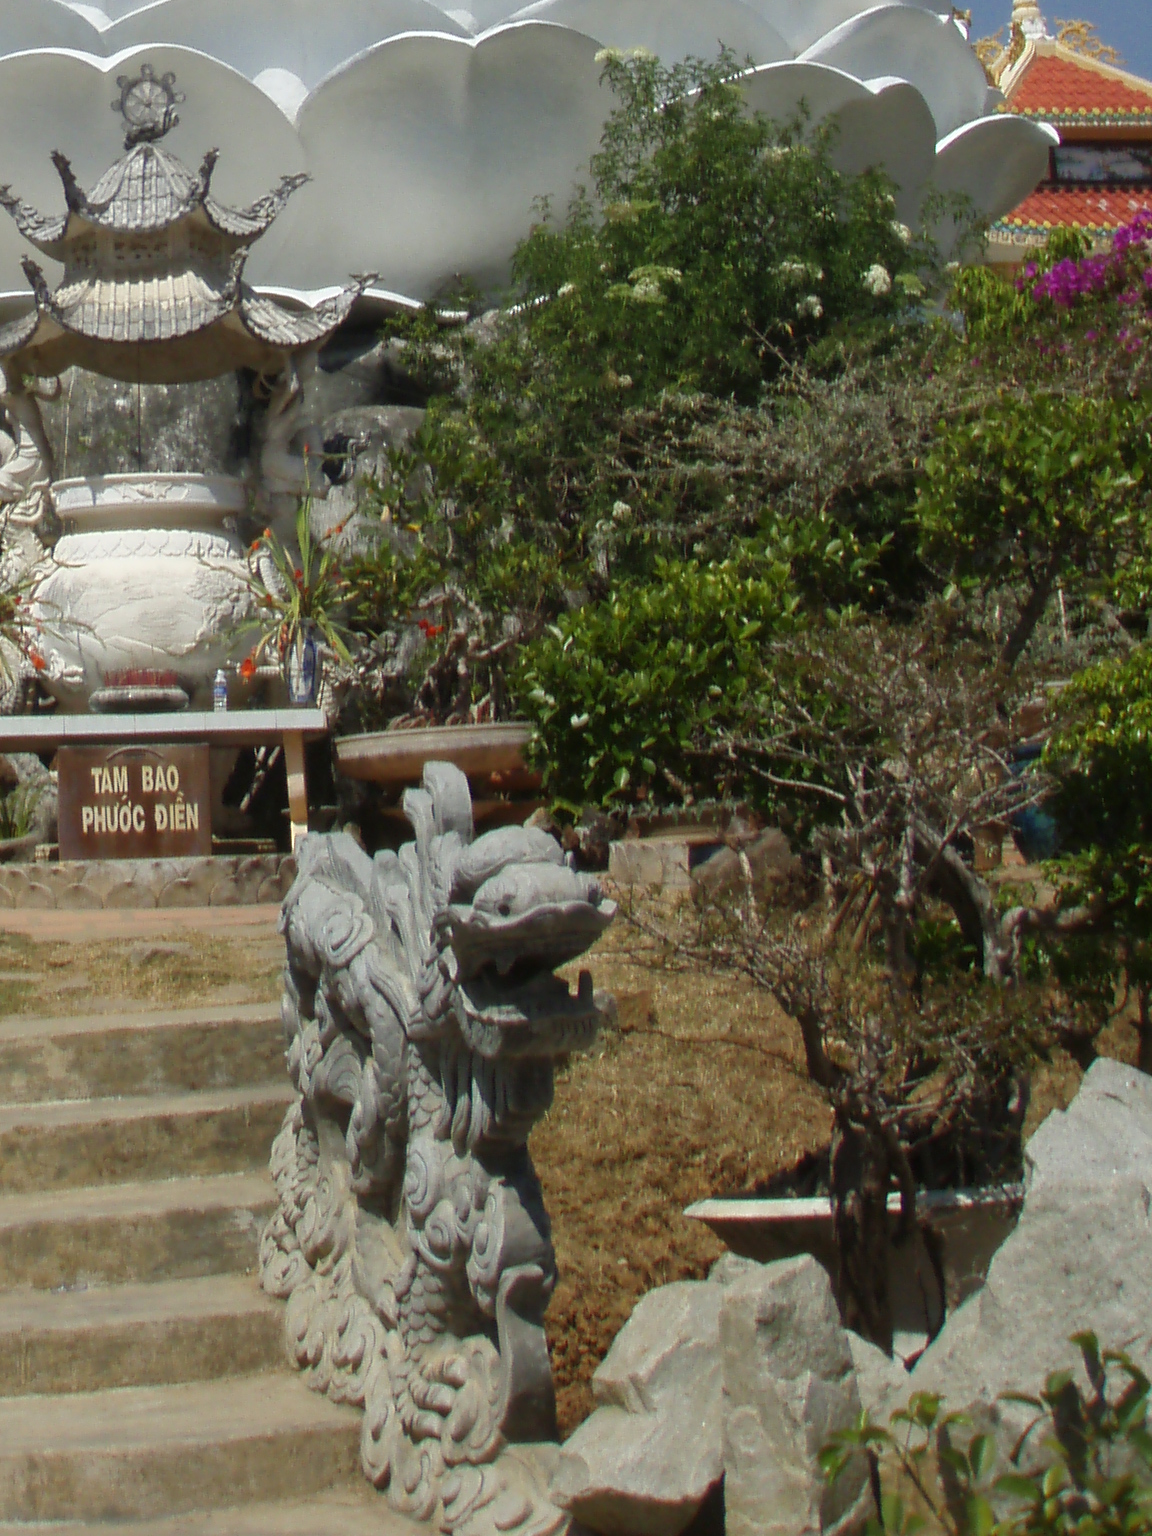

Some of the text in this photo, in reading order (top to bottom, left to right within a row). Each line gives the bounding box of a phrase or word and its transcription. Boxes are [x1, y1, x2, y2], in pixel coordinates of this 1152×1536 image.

[91, 766, 128, 794] TAM
[82, 791, 199, 833] PHƯỚC ĐIỀN
